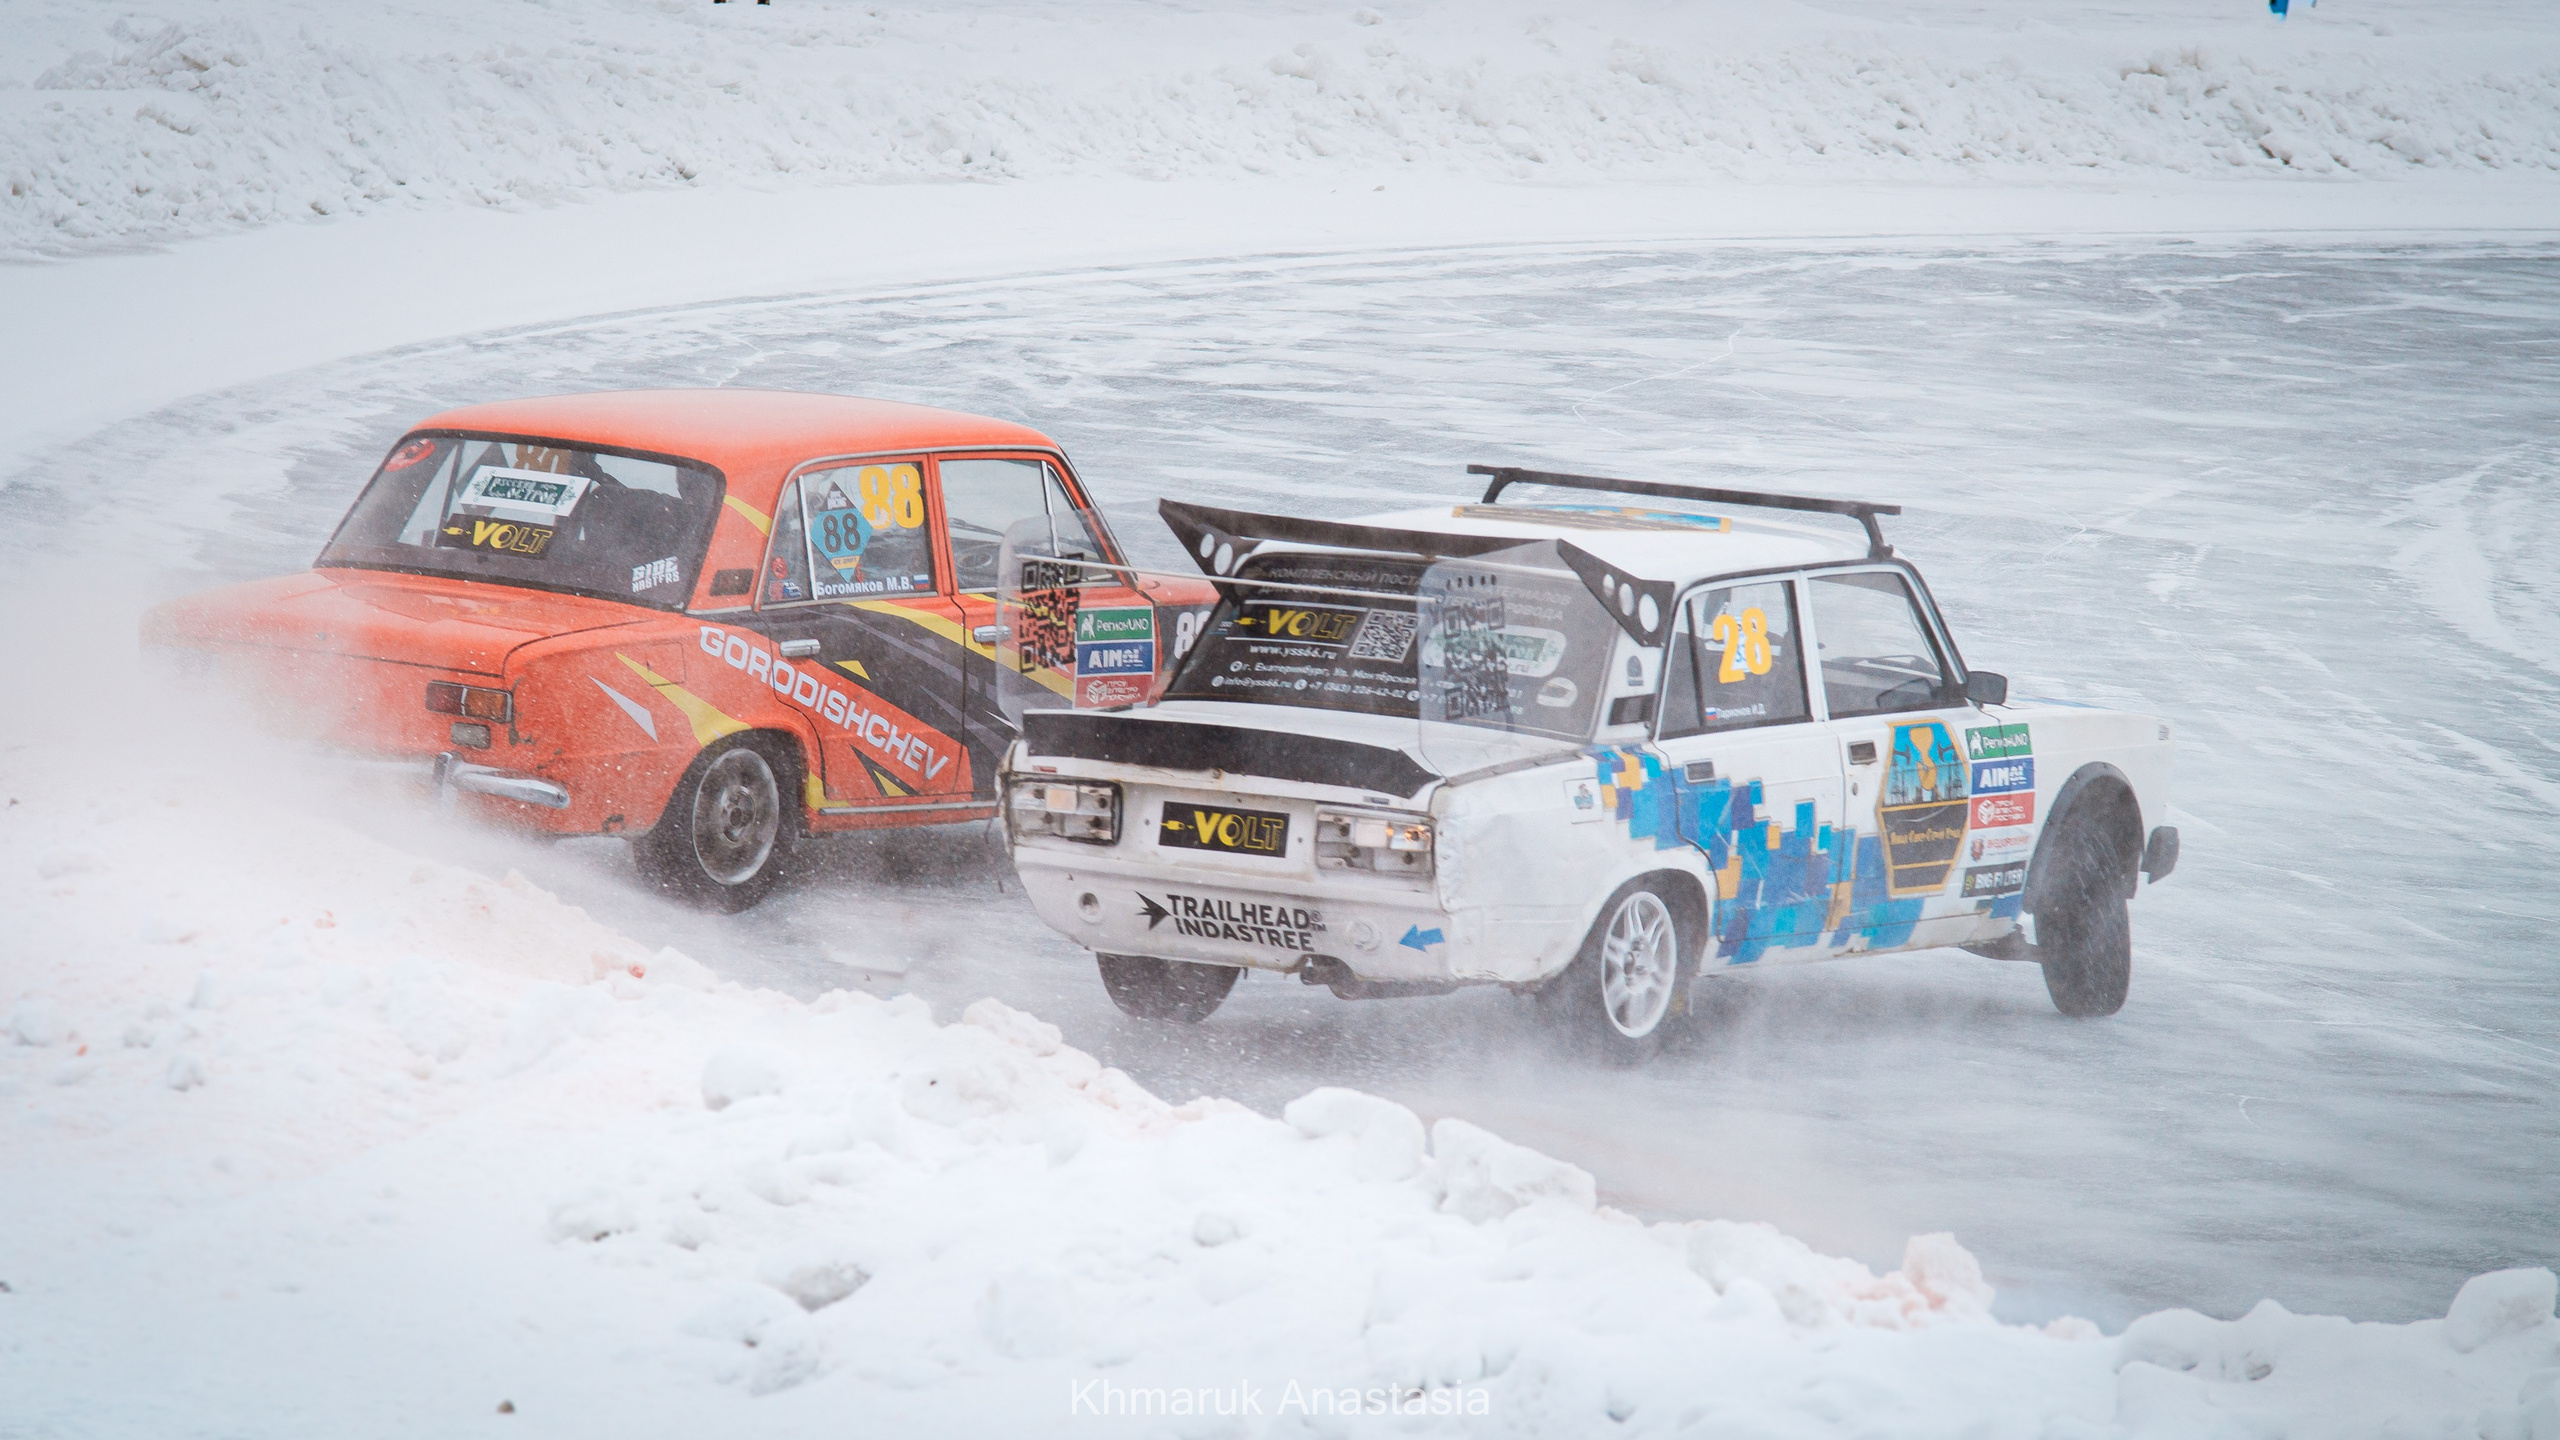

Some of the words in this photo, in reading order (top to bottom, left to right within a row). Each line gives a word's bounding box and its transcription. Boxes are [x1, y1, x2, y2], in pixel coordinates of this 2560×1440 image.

[859, 465, 925, 530] 88
[472, 520, 553, 554] VOLT
[823, 513, 861, 553] 88
[816, 580, 884, 596] Богомяков
[886, 576, 915, 591] М.В.
[1269, 609, 1357, 640] VOLT
[1712, 607, 1773, 684] 28
[700, 625, 949, 780] GORODISHCHEV
[1193, 810, 1285, 851] VOLT
[1174, 917, 1315, 952] INDASTREE
